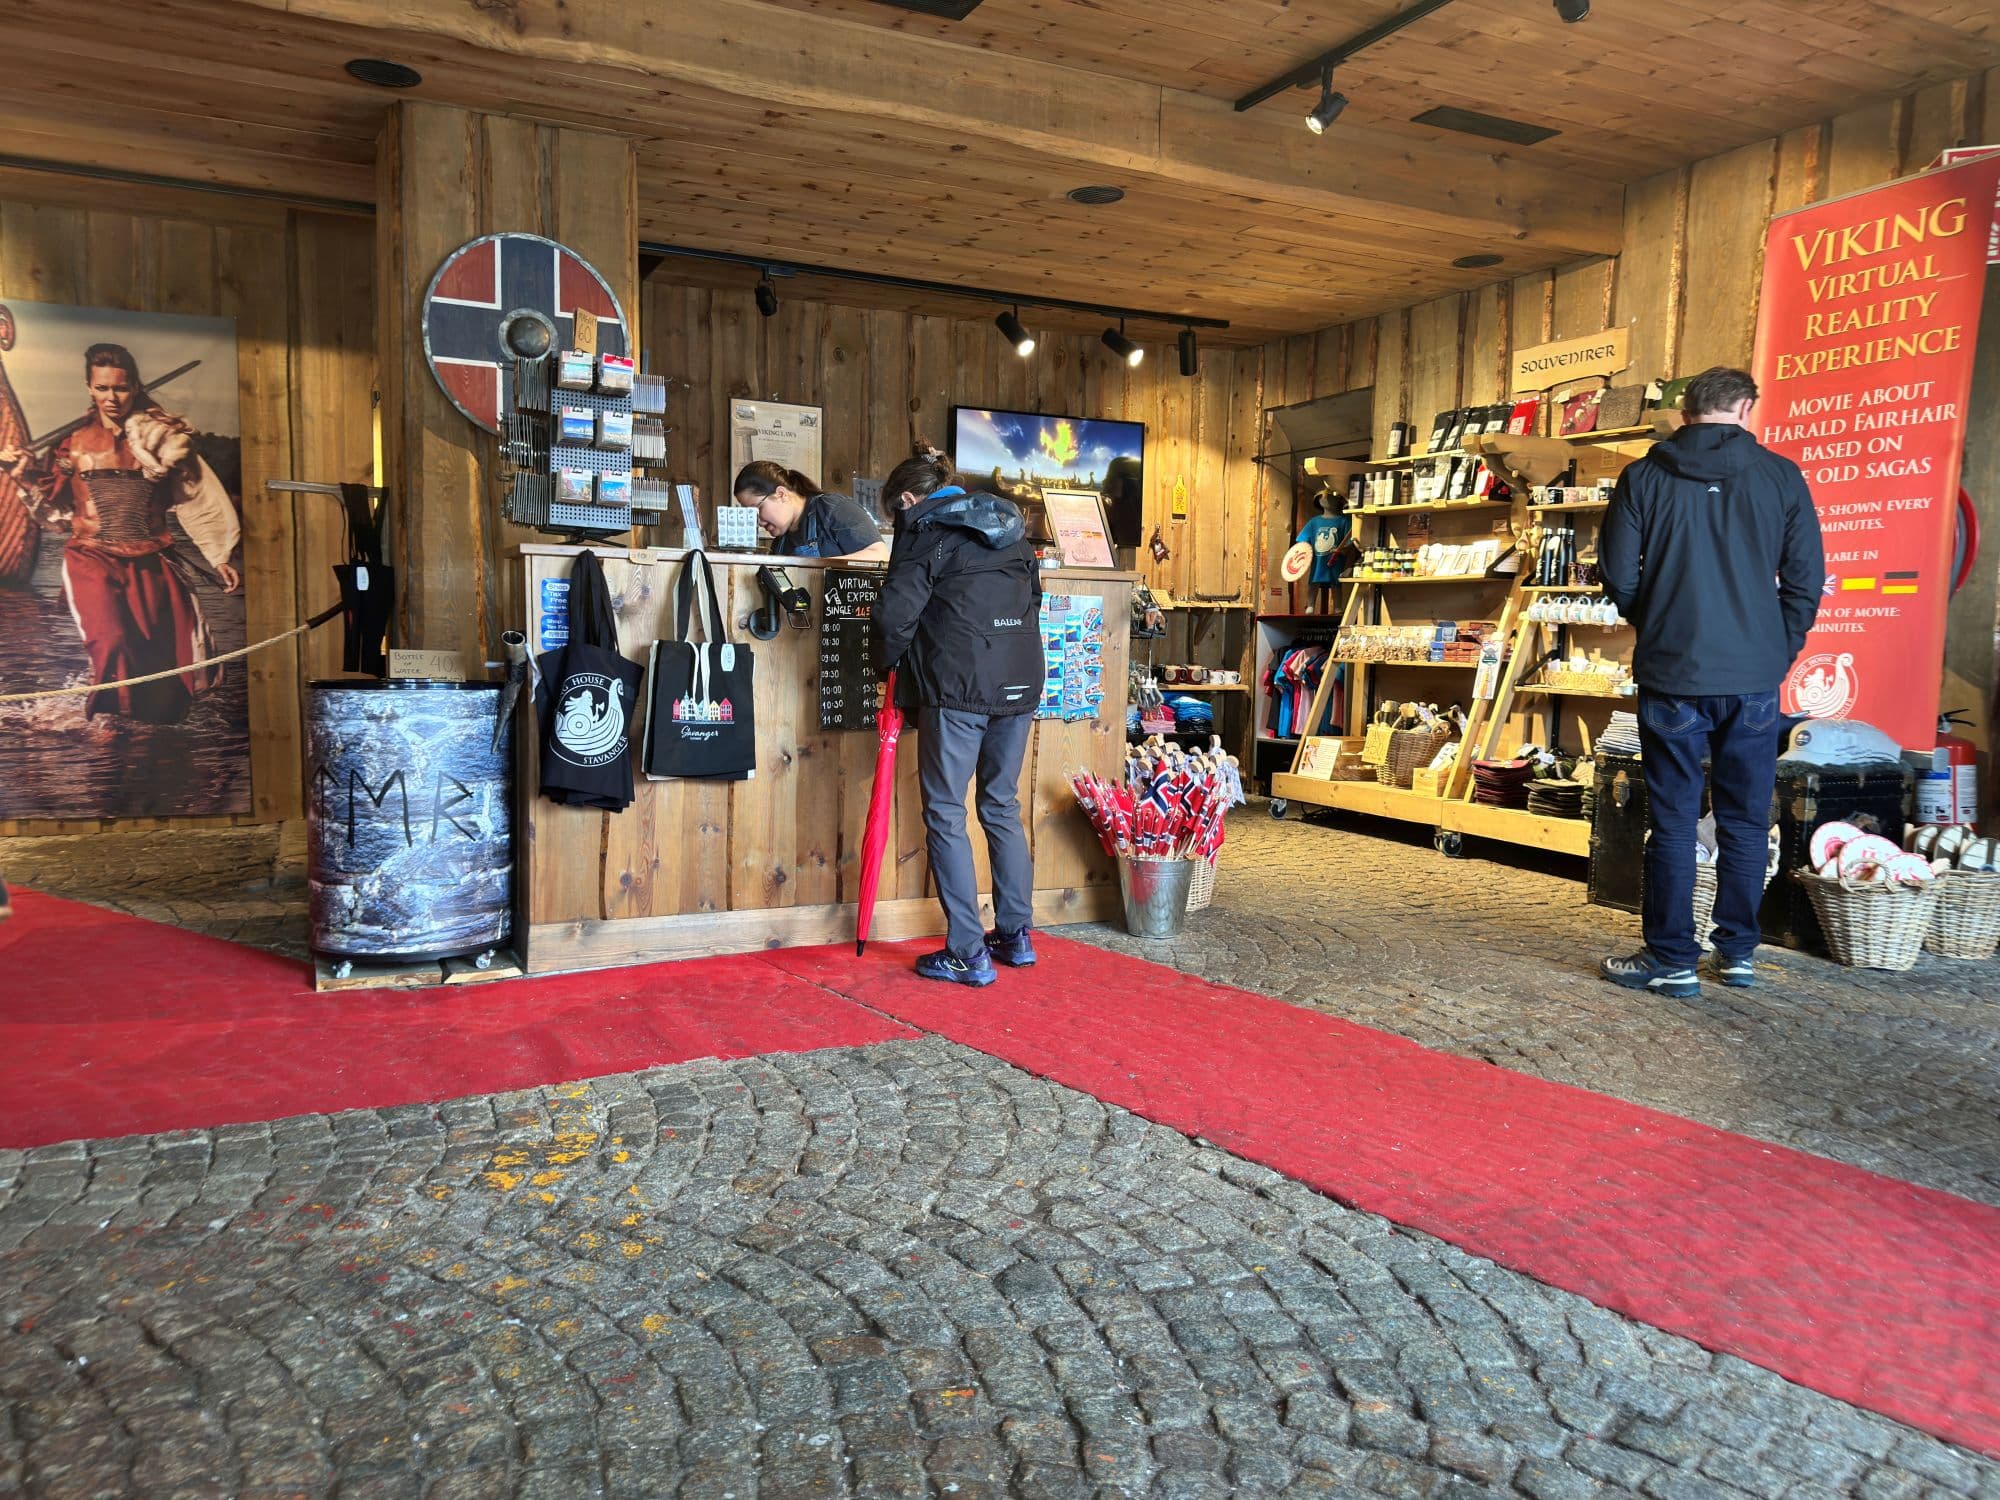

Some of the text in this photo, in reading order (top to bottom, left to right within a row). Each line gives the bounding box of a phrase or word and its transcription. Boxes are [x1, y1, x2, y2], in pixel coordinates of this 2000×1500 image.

[1790, 198, 1968, 271] VIKING
[1808, 255, 1940, 303] VIRTUAL
[1804, 292, 1938, 340] REALITY
[1521, 344, 1615, 374] SOUVENIRER
[1775, 326, 1961, 380] EXPERIENCE
[1788, 381, 1935, 418] MOVIE ABOUT
[758, 428, 779, 437] VIKING
[1763, 403, 1959, 444] HARALD FAIRHAIR
[1801, 435, 1903, 462] BASED ON
[1816, 461, 1859, 483] OLD
[1865, 457, 1932, 479] SAGAS
[1828, 501, 1882, 516] SHOWN
[1886, 497, 1933, 511] EVERY
[1820, 518, 1885, 533] MINUTES.
[1824, 550, 1879, 562] LABLE IN
[838, 577, 874, 590] VIRTUAL
[846, 591, 878, 602] EXPERI
[1835, 607, 1852, 618] OF
[1854, 606, 1901, 617] MOVIE:
[571, 675, 604, 686] HOUSE
[821, 685, 842, 695] 10:00
[822, 699, 844, 709] 10:30
[583, 735, 628, 764] STAVANGER
